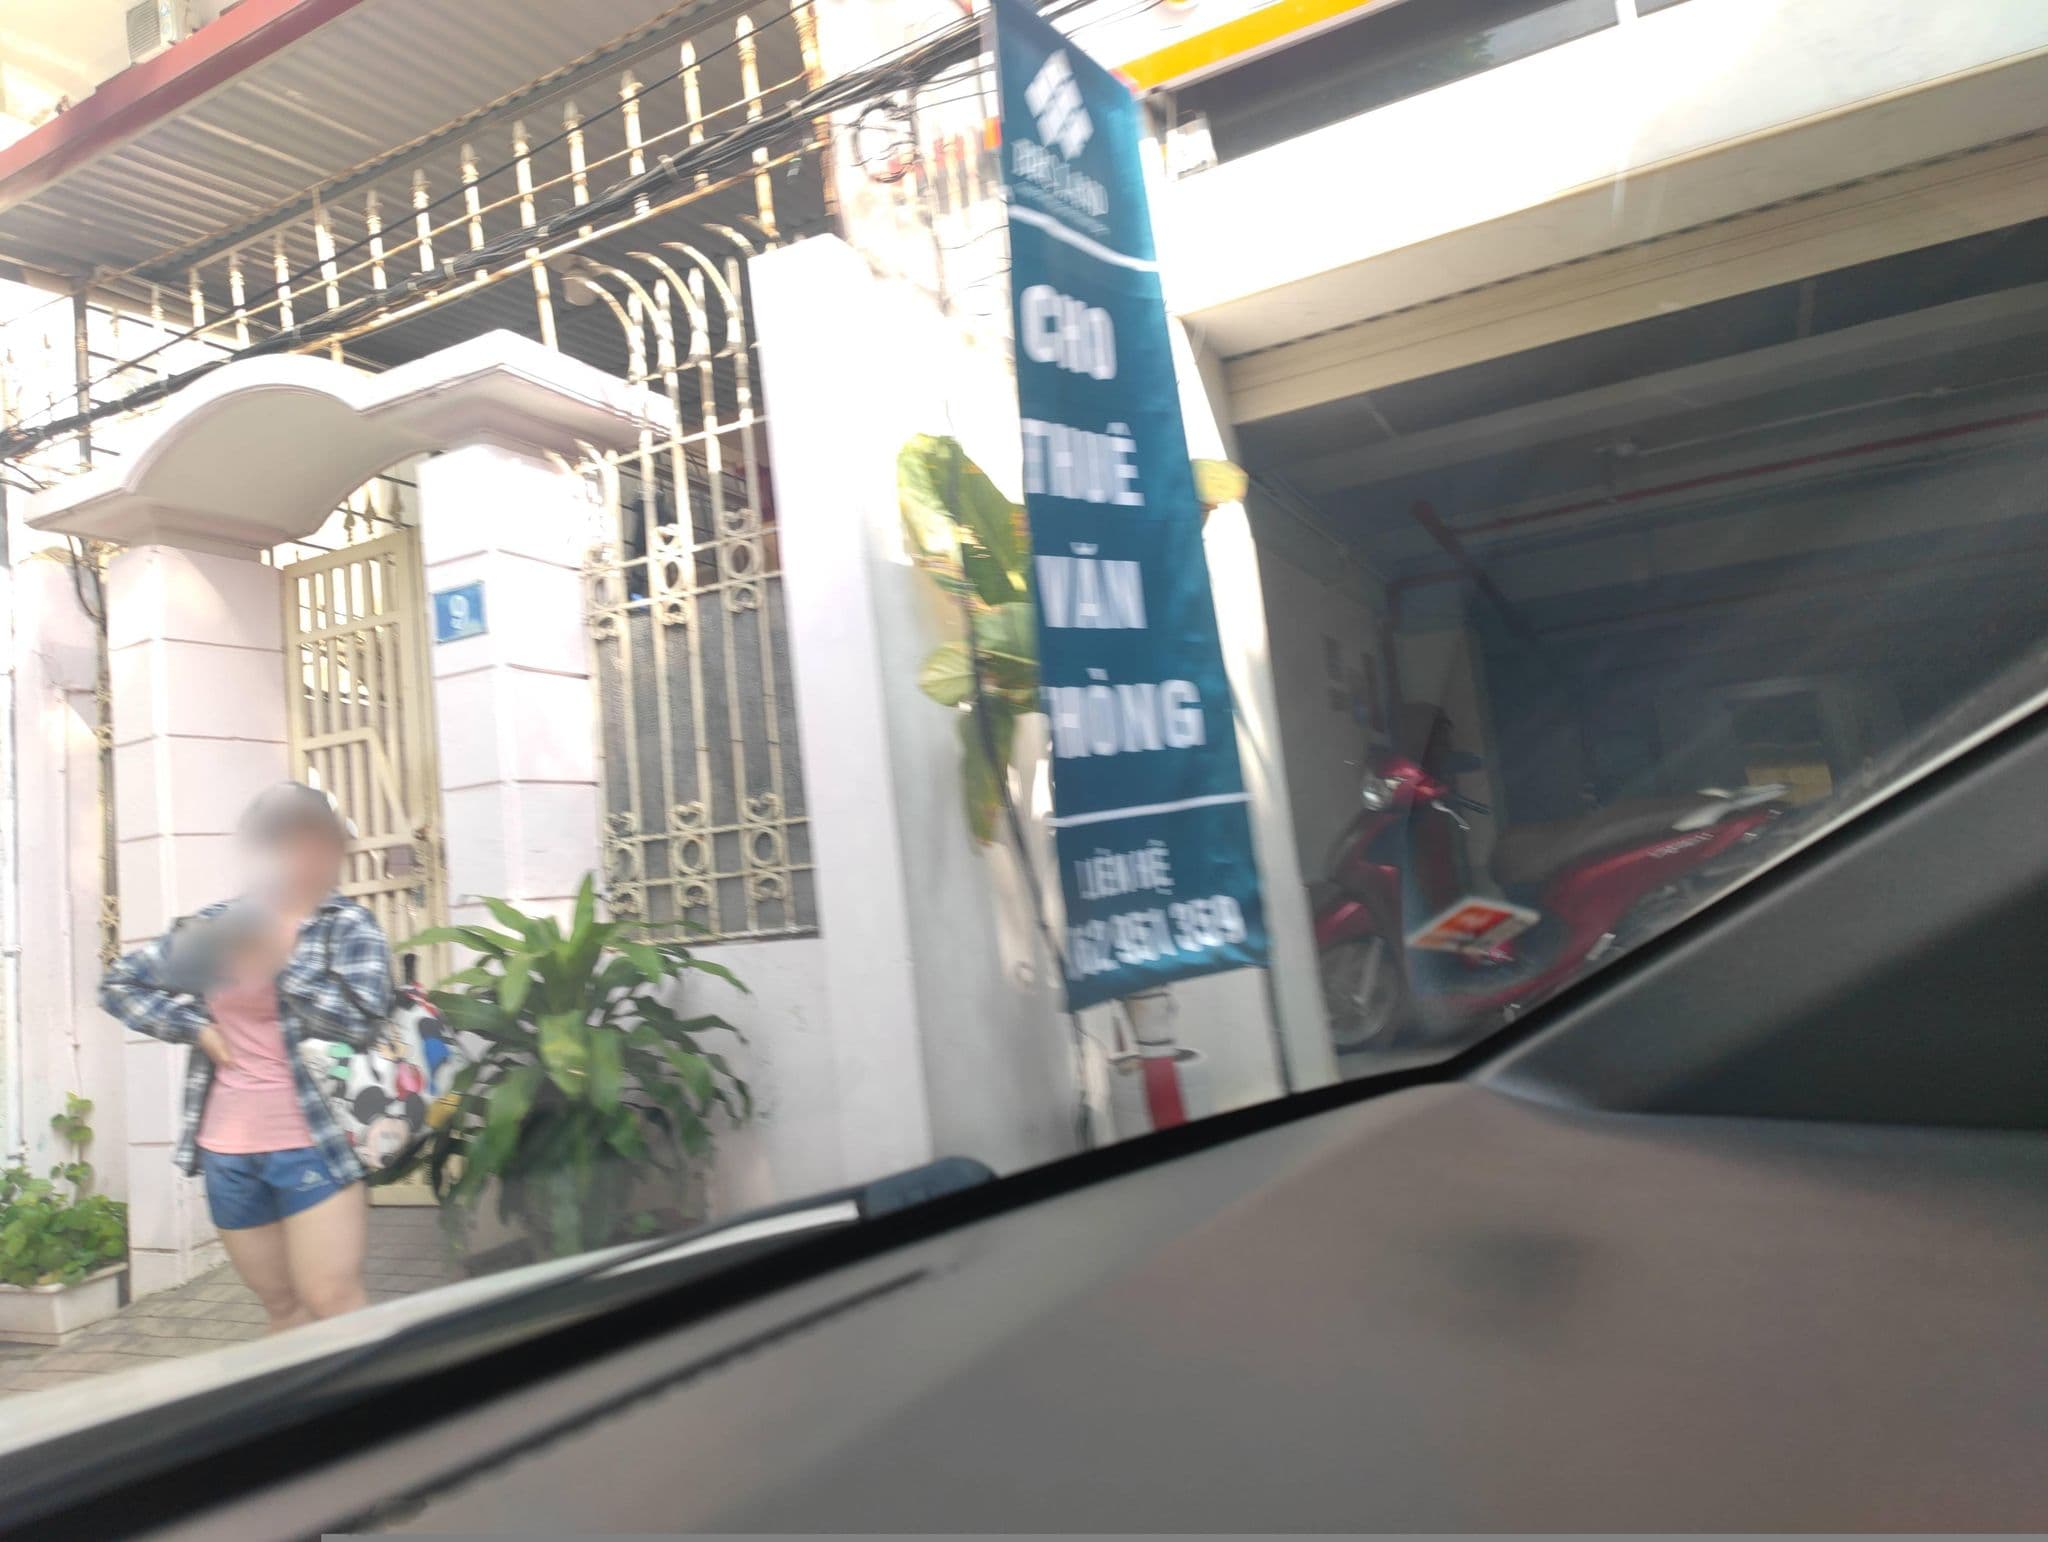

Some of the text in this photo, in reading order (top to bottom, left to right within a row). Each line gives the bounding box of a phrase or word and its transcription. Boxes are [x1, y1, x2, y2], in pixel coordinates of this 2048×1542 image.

[1021, 285, 1117, 379] CHO
[1022, 418, 1145, 506] THUÊ
[1034, 542, 1148, 629] VĂN
[1040, 668, 1207, 759] HÒNG
